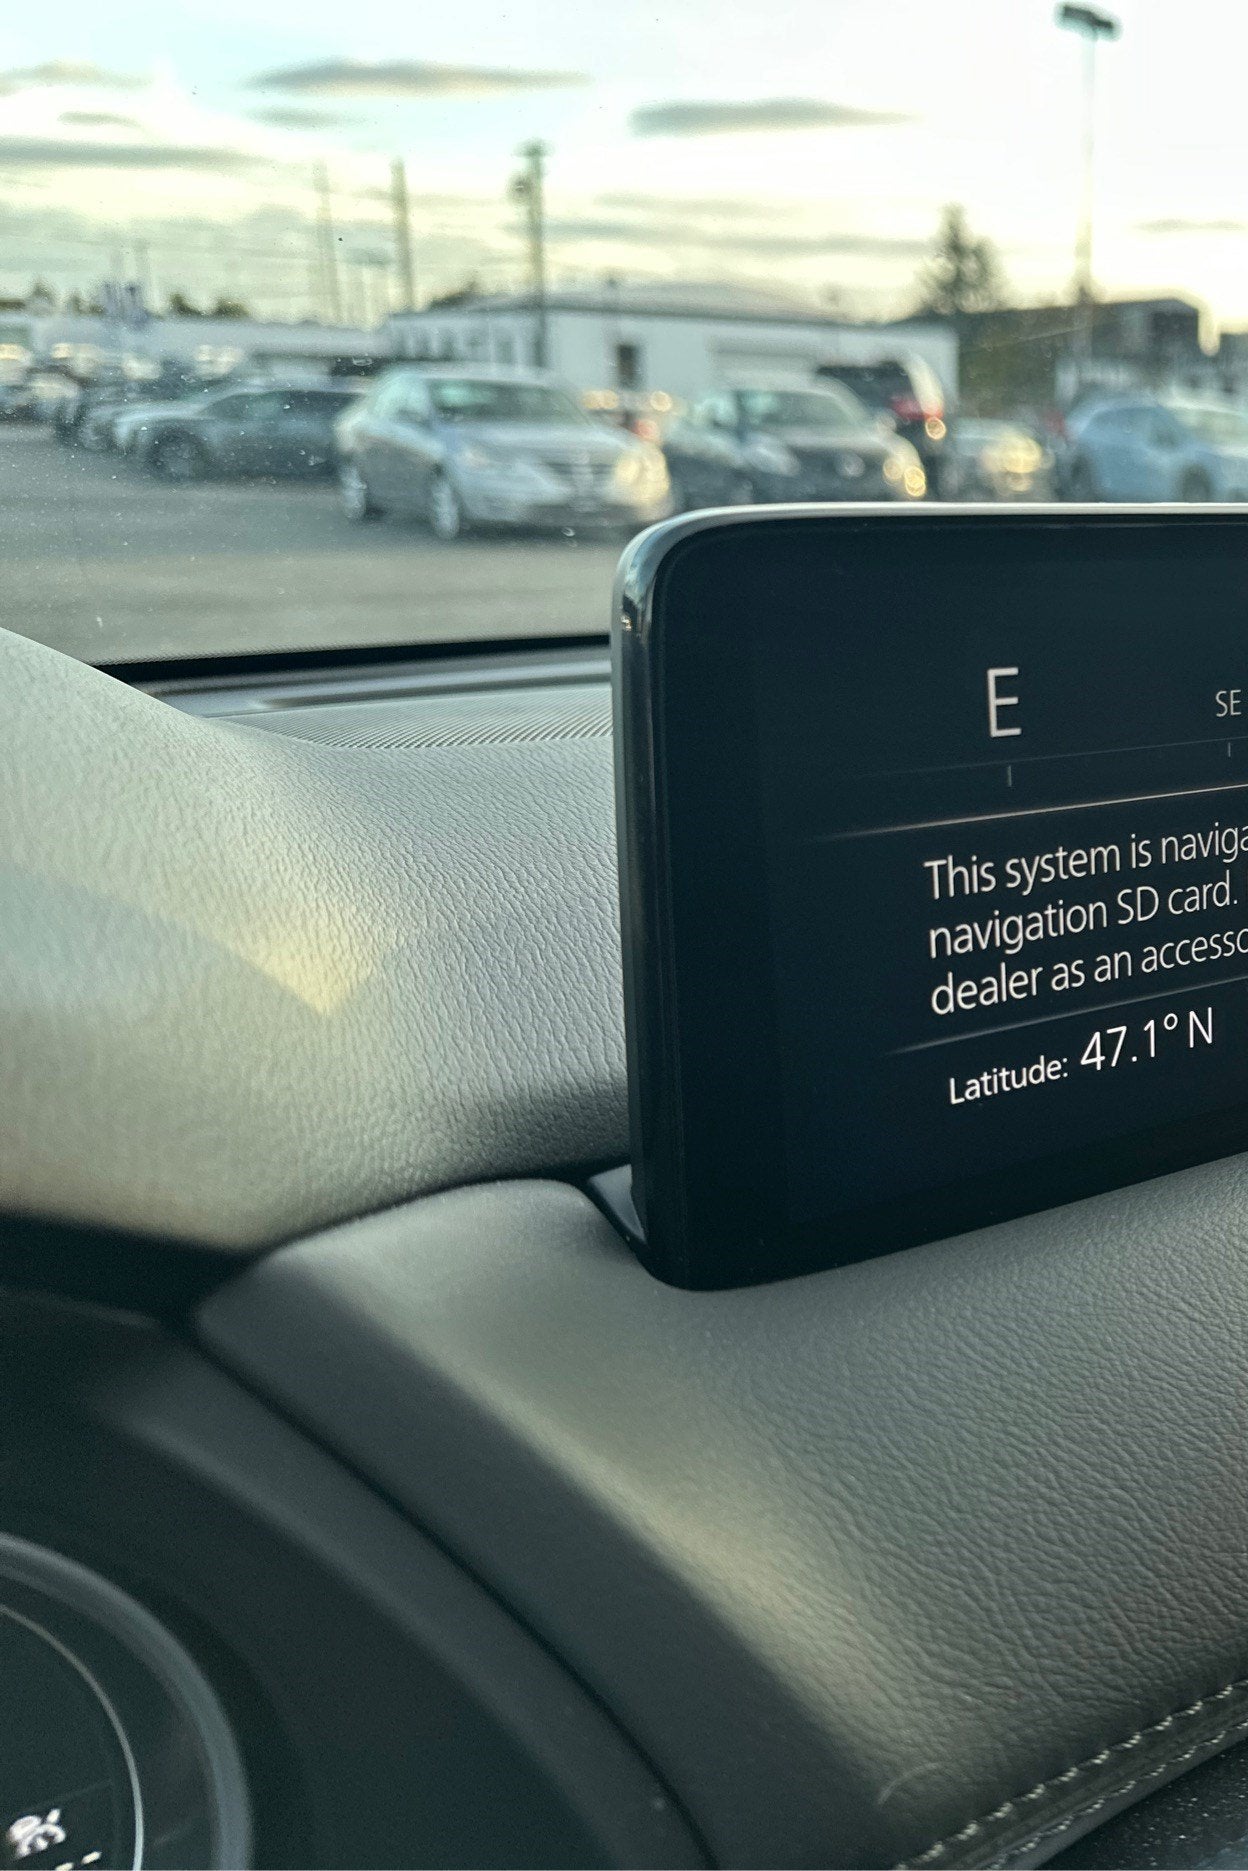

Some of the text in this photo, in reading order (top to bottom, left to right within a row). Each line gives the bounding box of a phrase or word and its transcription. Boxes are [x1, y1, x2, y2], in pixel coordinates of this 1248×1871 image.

[987, 667, 1021, 738] E
[1215, 689, 1242, 717] SE
[924, 854, 996, 900] This
[1005, 844, 1120, 896] system
[1131, 833, 1151, 868] is
[929, 899, 1108, 959] navigation
[1117, 886, 1159, 925] SD
[1168, 869, 1238, 915] card.
[931, 961, 1044, 1015] dealer
[1051, 959, 1086, 991] as
[1094, 950, 1132, 983] an
[950, 1007, 1213, 1105] Latitude: 47.1° N
